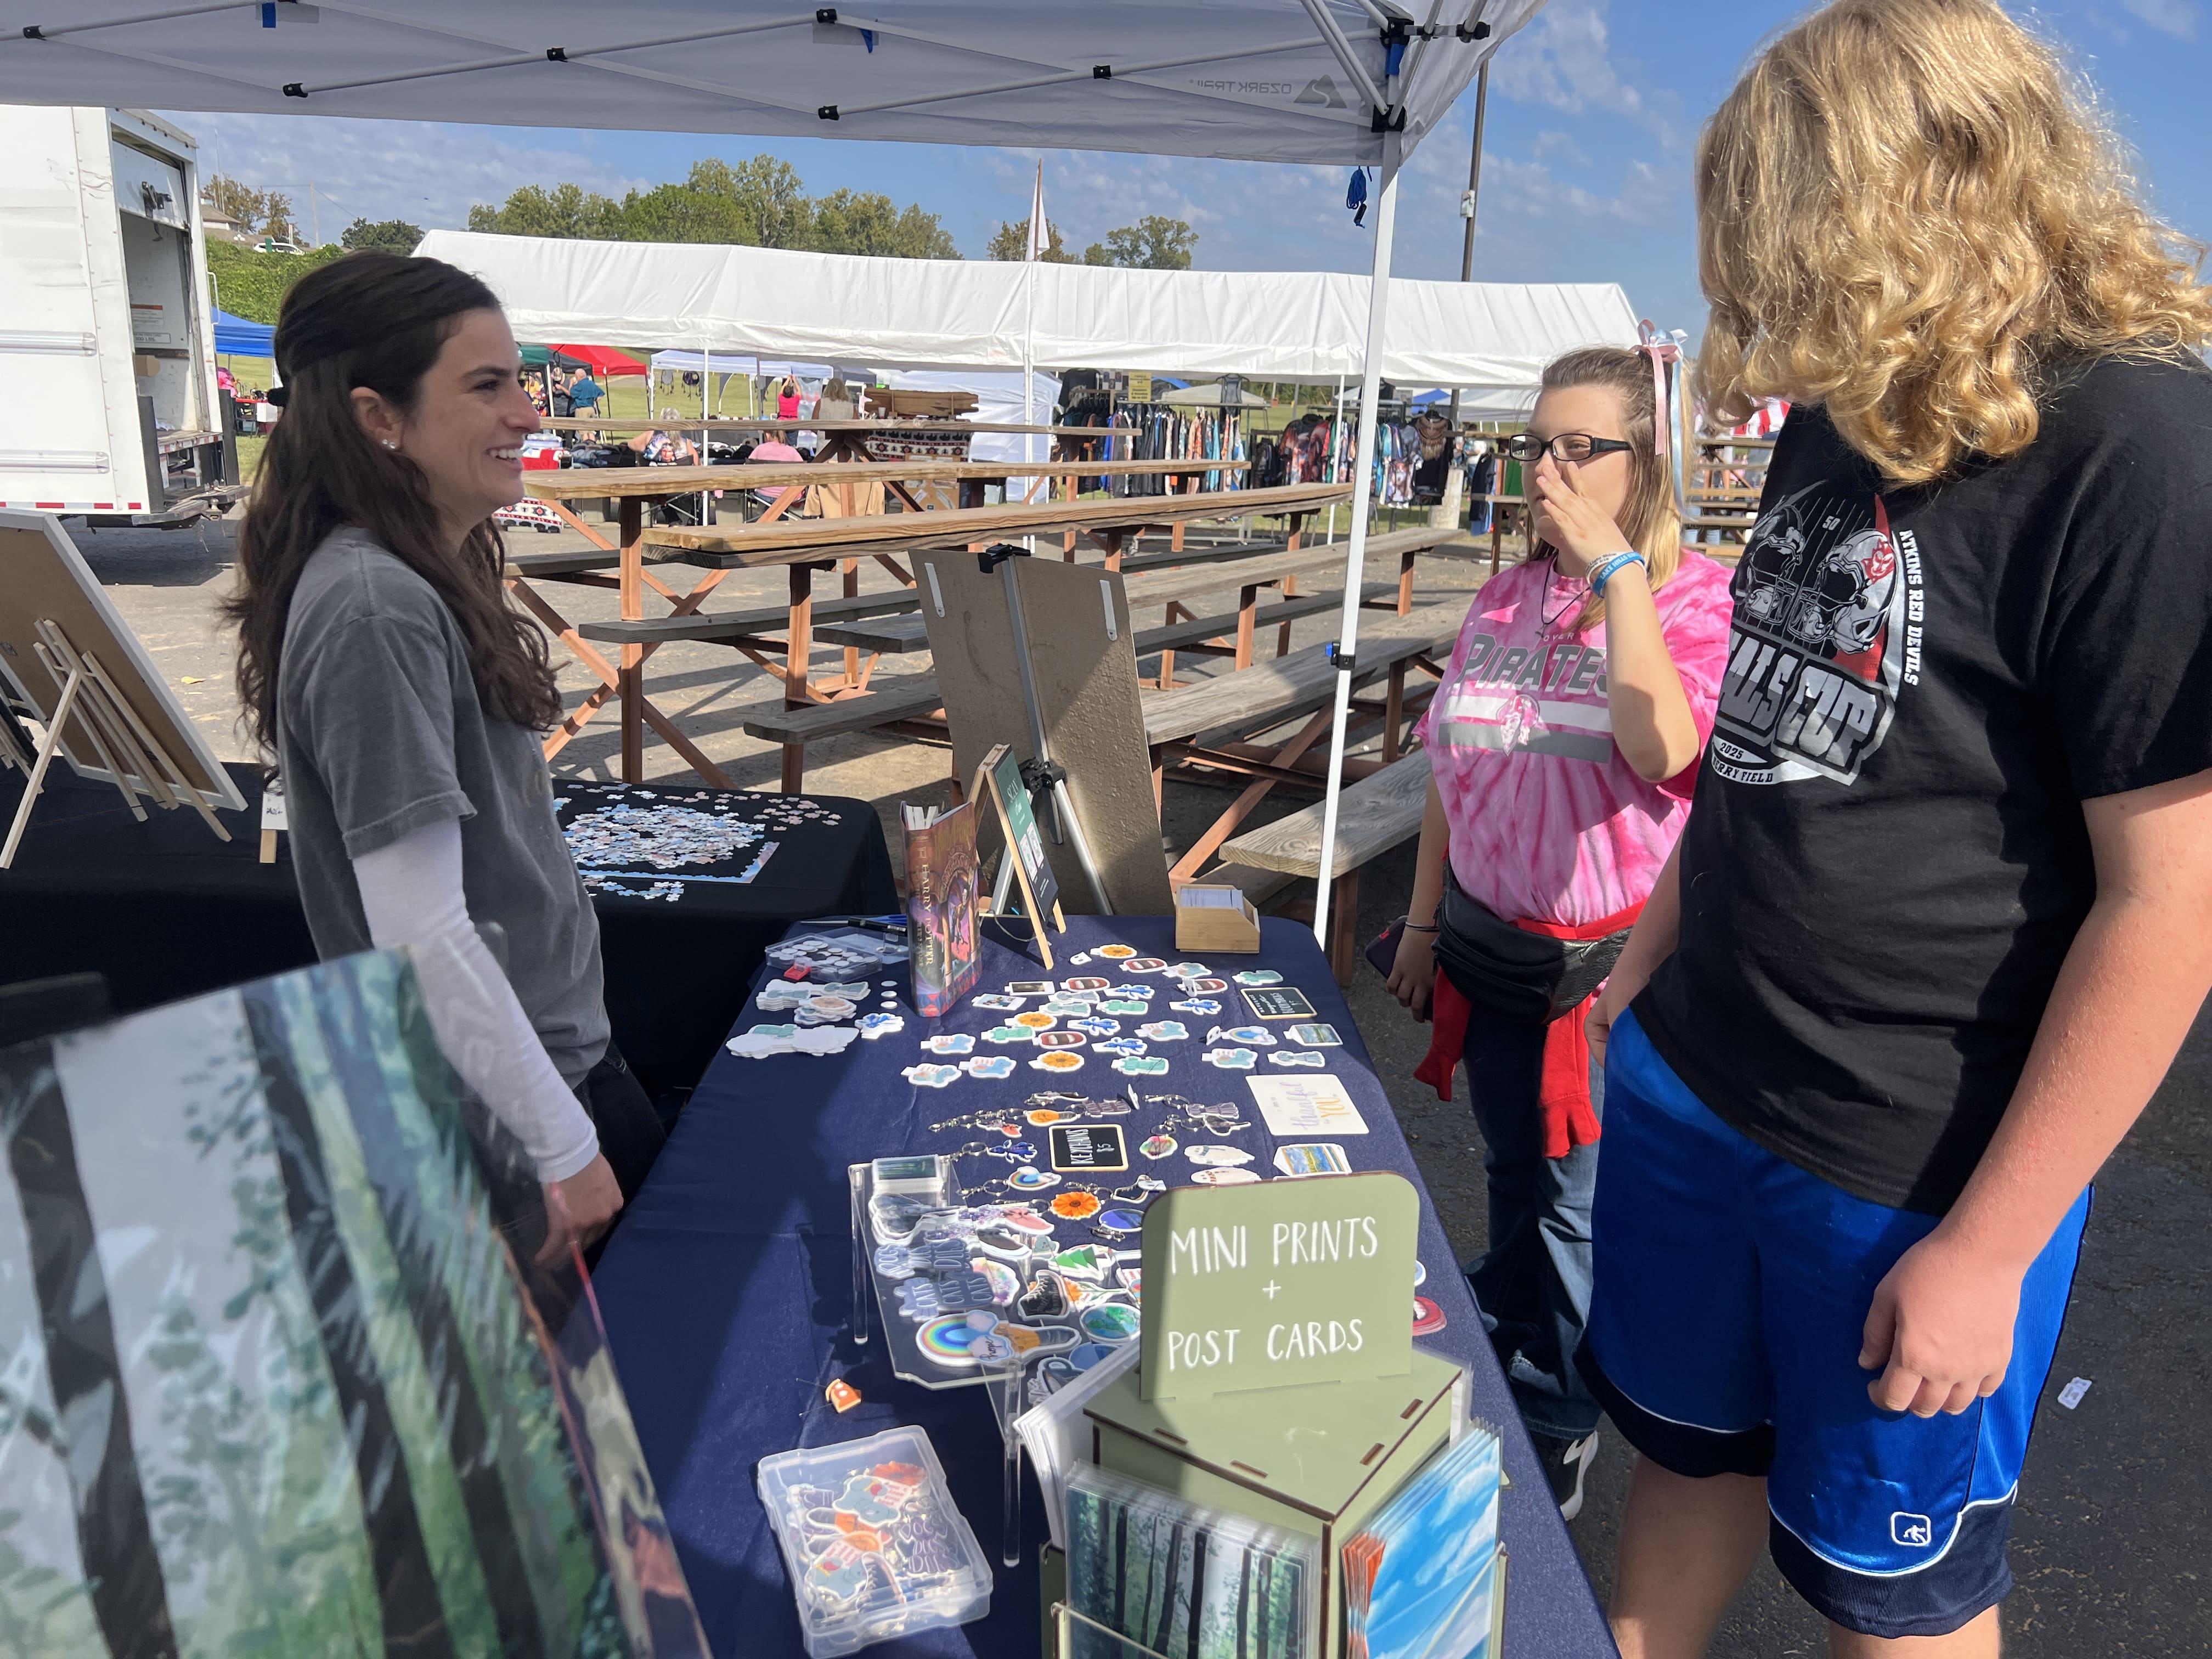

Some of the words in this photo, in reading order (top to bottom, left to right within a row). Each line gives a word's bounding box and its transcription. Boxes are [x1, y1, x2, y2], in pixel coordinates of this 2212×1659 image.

[1822, 515, 1840, 531] 50
[1599, 565, 1613, 580] LAKE
[1611, 553, 1630, 568] HILLS
[1899, 530, 1922, 585] ATKINS
[1908, 589, 1923, 621] RED
[1904, 627, 1923, 686] DEVILS
[1776, 665, 1877, 768] CUP
[1719, 742, 1744, 759] 2025
[1741, 771, 1773, 782] FIELD
[921, 864, 932, 913] HARRY
[924, 917, 934, 966] POTTER
[1280, 1082, 1319, 1130] thankful
[1313, 1097, 1351, 1118] YOU
[1065, 1129, 1094, 1165] KEYCHAINS
[1096, 1143, 1115, 1153] $5
[878, 1244, 902, 1274] DOGS
[1171, 1224, 1246, 1276] MINI
[1273, 1216, 1378, 1266] PRINTS
[912, 1283, 939, 1307] CATS
[938, 1280, 965, 1304] CATS
[966, 1277, 993, 1301] CATS
[1262, 1279, 1282, 1300] +
[979, 1335, 1002, 1360] hope
[1168, 1329, 1241, 1372] POST
[1267, 1319, 1363, 1361] CARDS
